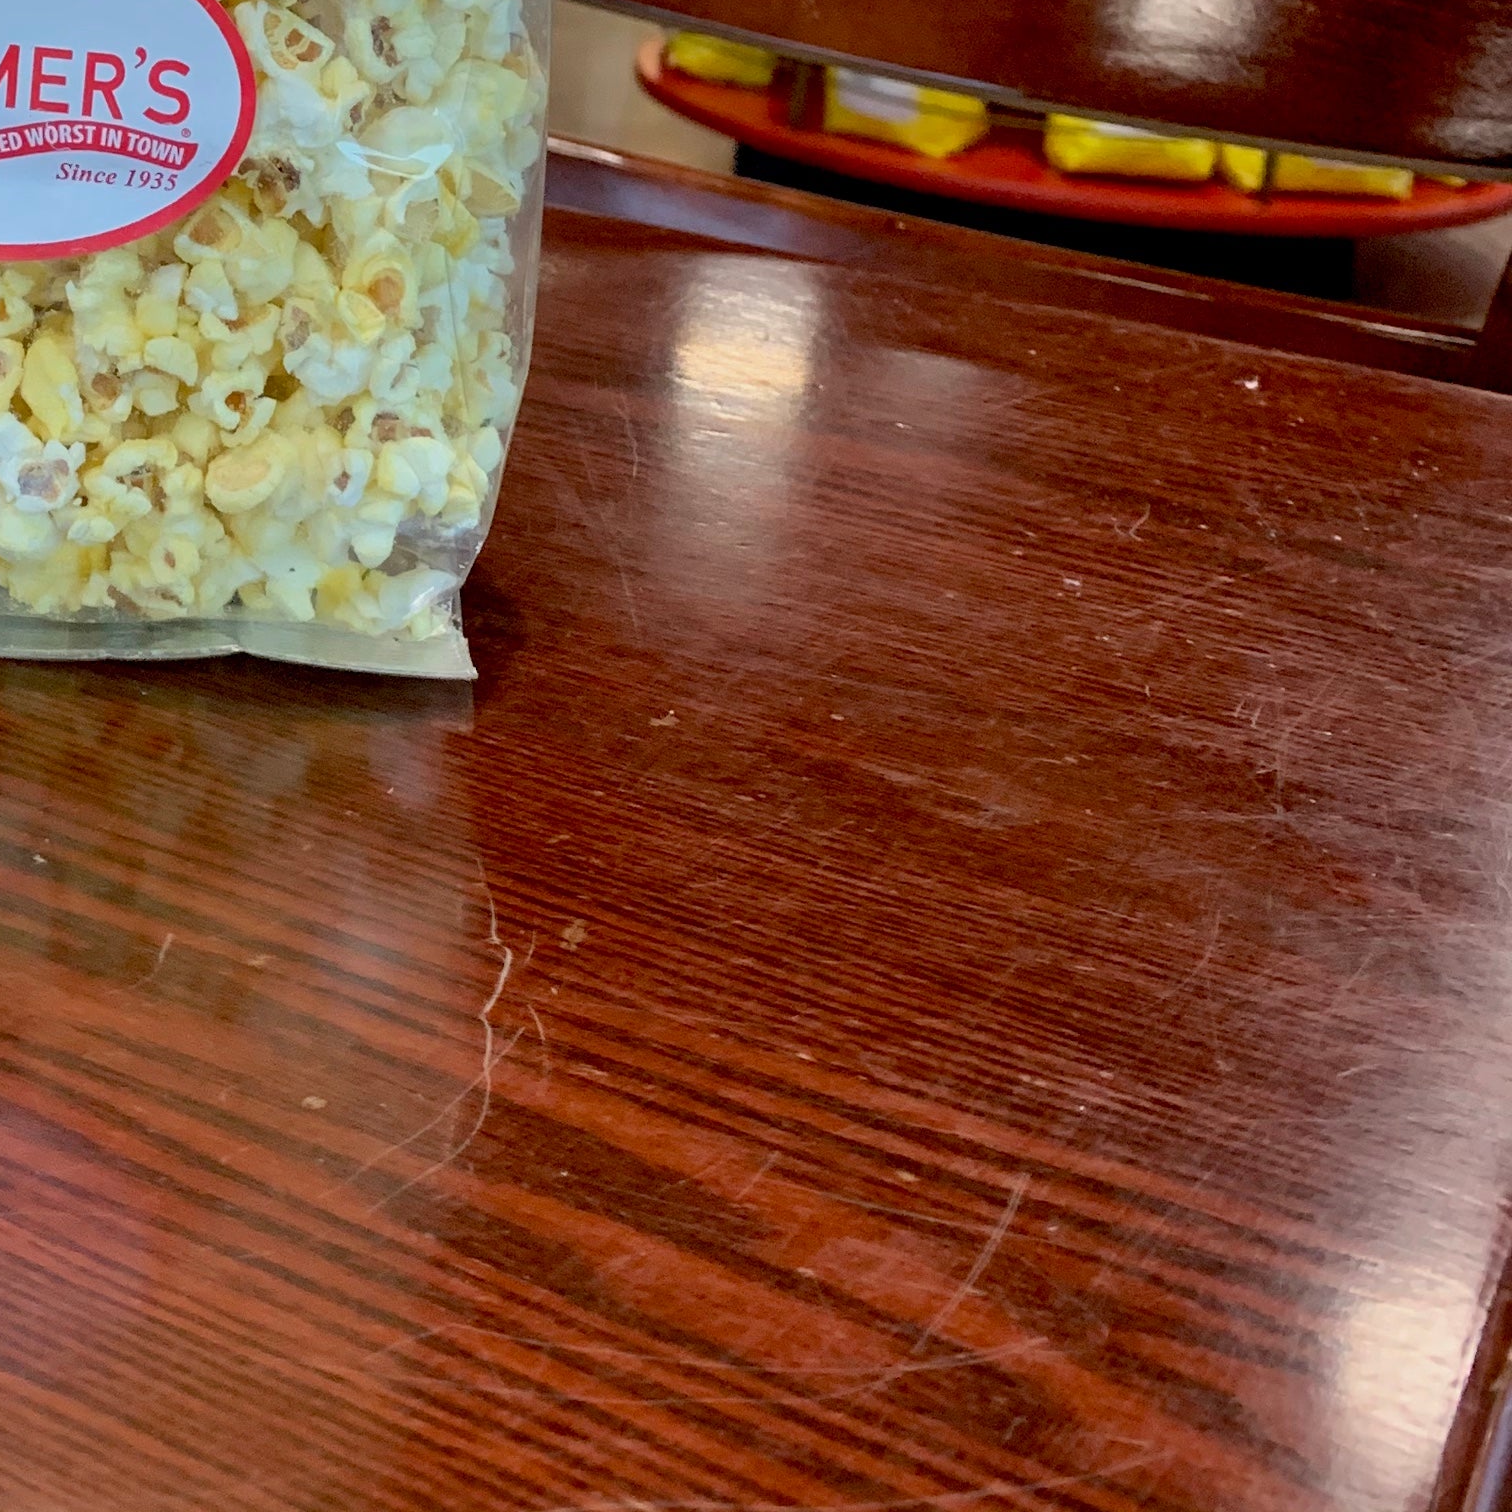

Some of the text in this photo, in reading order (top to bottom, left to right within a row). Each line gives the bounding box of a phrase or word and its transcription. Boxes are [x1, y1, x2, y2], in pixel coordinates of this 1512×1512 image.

[24, 125, 96, 148] WORST
[100, 128, 123, 149] IN
[127, 133, 185, 165] TOWN
[56, 162, 179, 191] Since 1935
